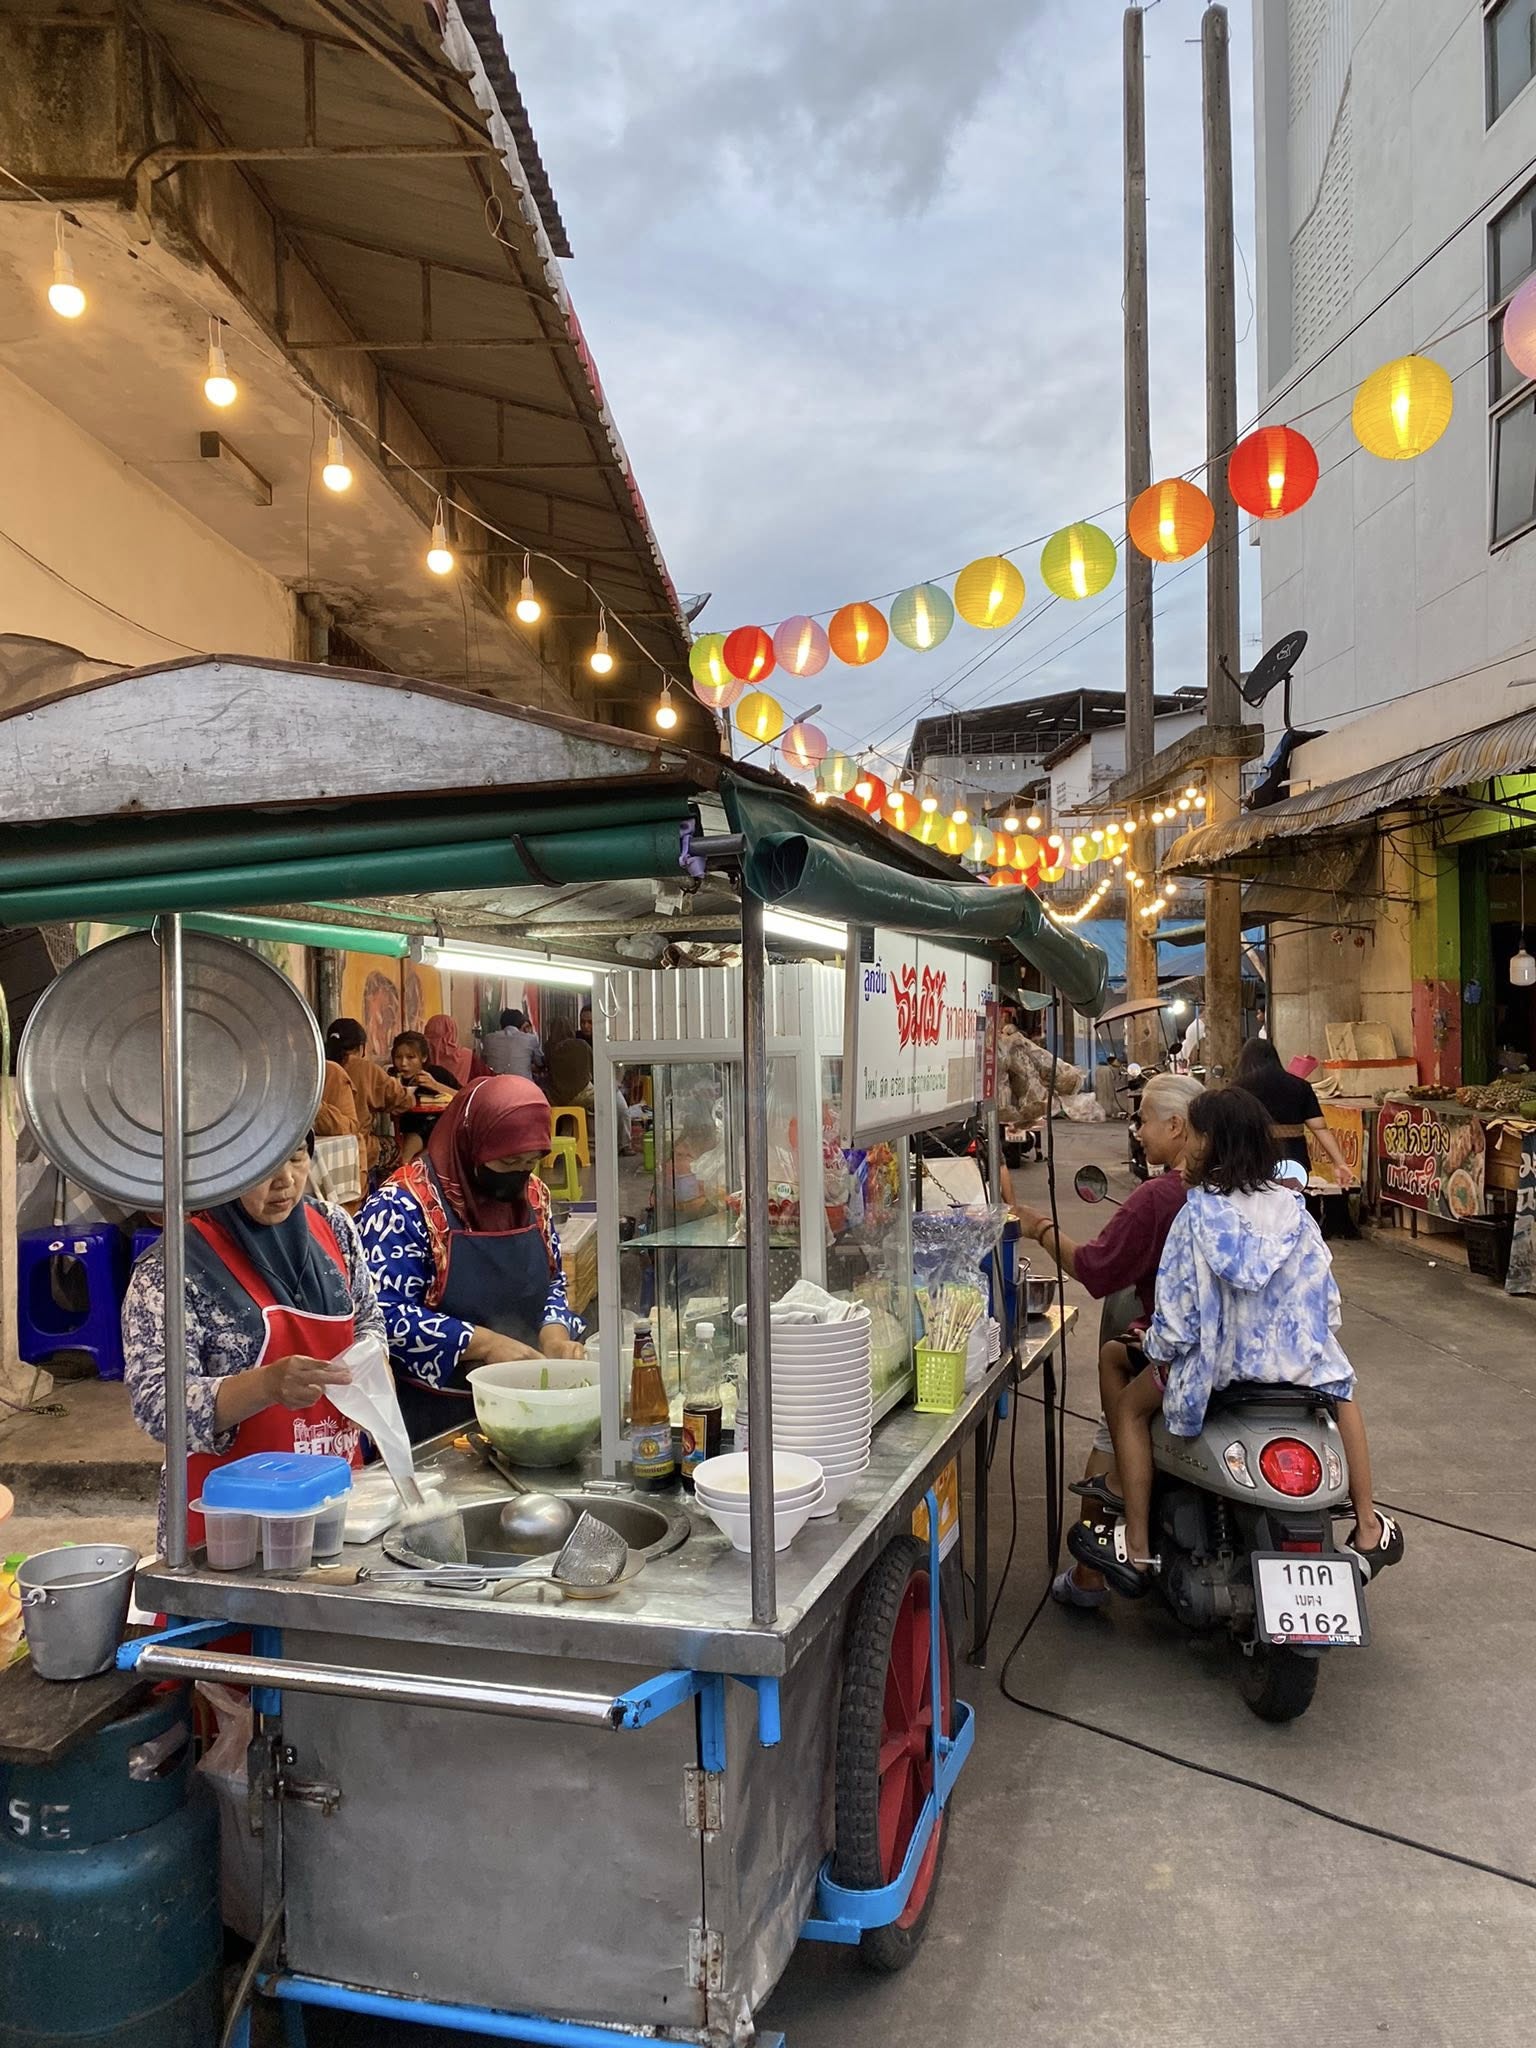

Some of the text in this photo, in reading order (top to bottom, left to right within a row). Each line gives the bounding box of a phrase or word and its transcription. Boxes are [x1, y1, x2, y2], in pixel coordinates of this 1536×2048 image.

[864, 956, 887, 1001] ลูกชิ้น
[1384, 1108, 1451, 1156] หมึกย่าง
[1295, 1595, 1322, 1606] เบตง
[1279, 1612, 1349, 1634] 6162
